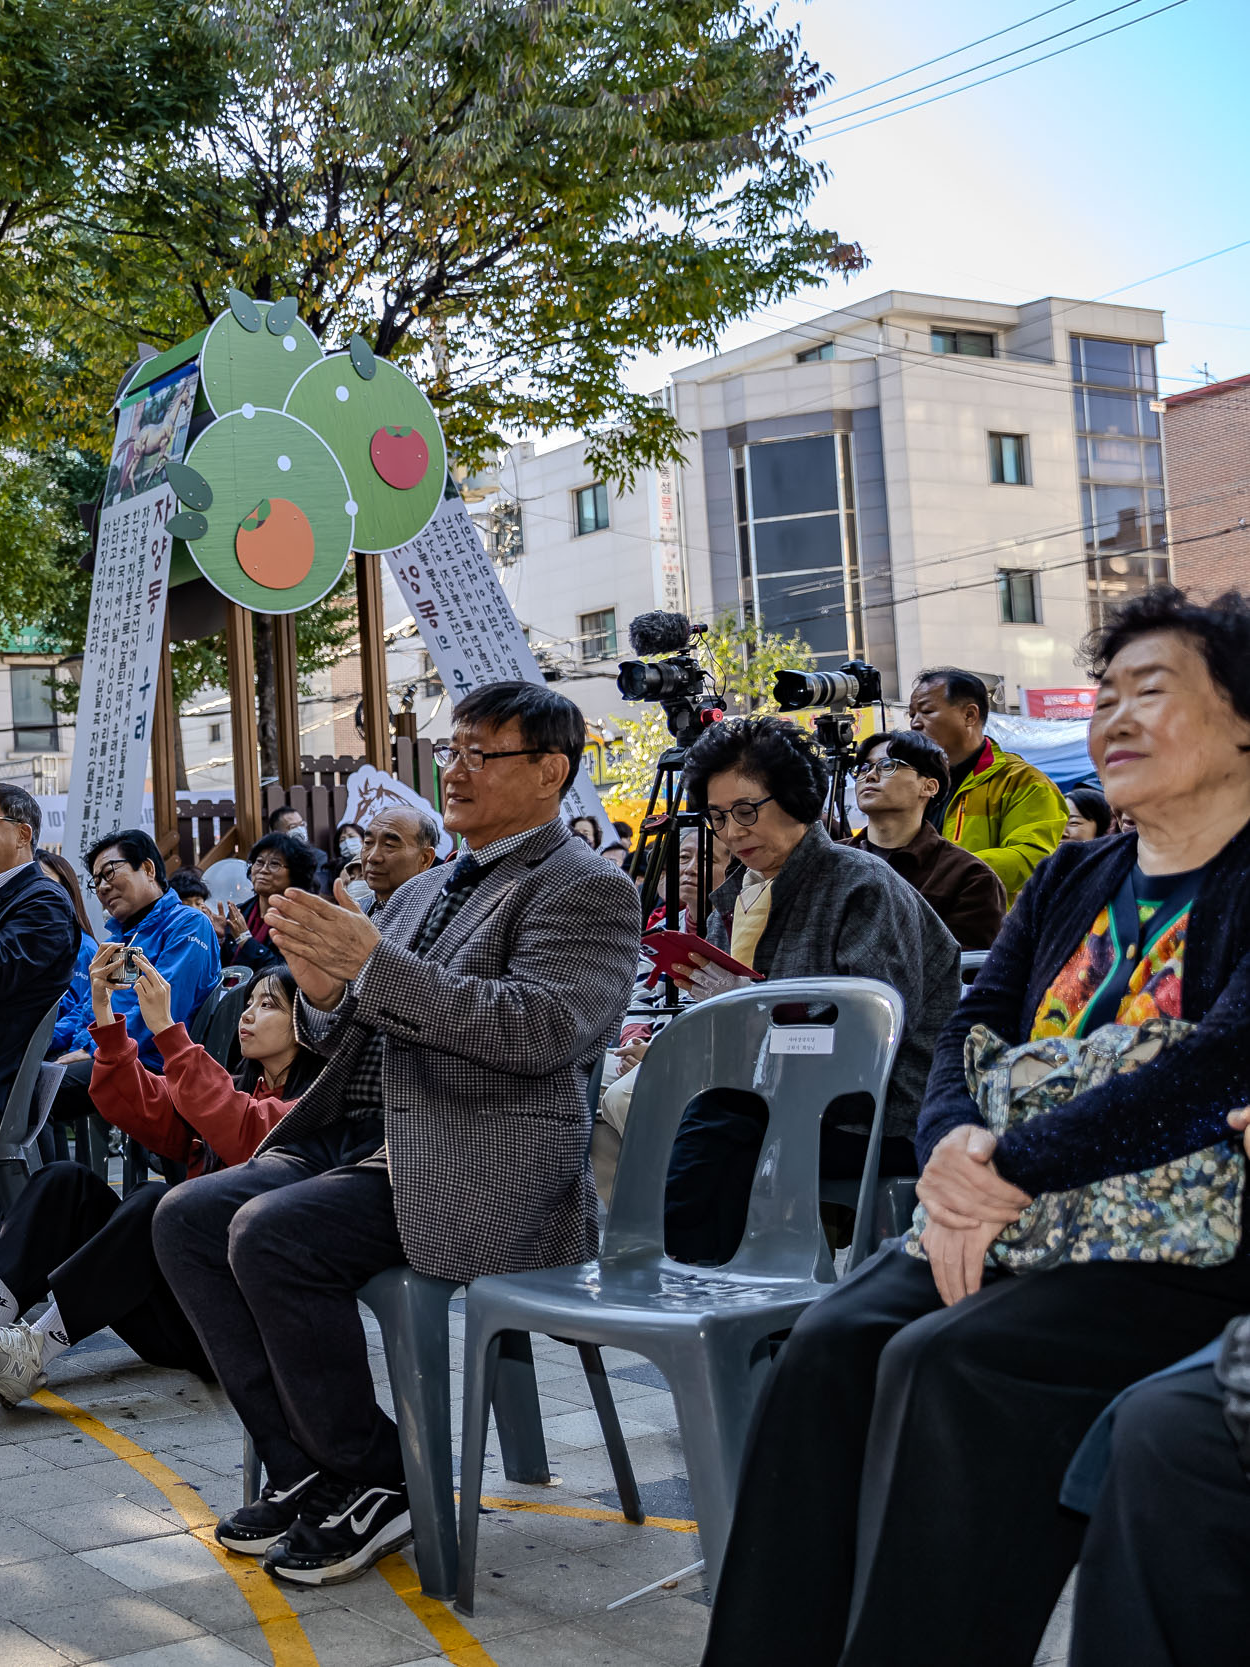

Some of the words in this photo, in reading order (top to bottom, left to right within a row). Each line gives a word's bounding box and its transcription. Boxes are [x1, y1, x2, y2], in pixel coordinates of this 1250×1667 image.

[95, 520, 112, 593] 자마장이라
[109, 515, 121, 560] 난다고
[138, 503, 151, 552] 자양동
[106, 563, 116, 593] 하여
[112, 563, 126, 624] 국가에서
[120, 559, 137, 635] 자양동으로
[134, 552, 146, 599] 동명은
[97, 615, 111, 674] 지역에서
[127, 602, 142, 663] 조선시대
[132, 664, 152, 742] 유래
